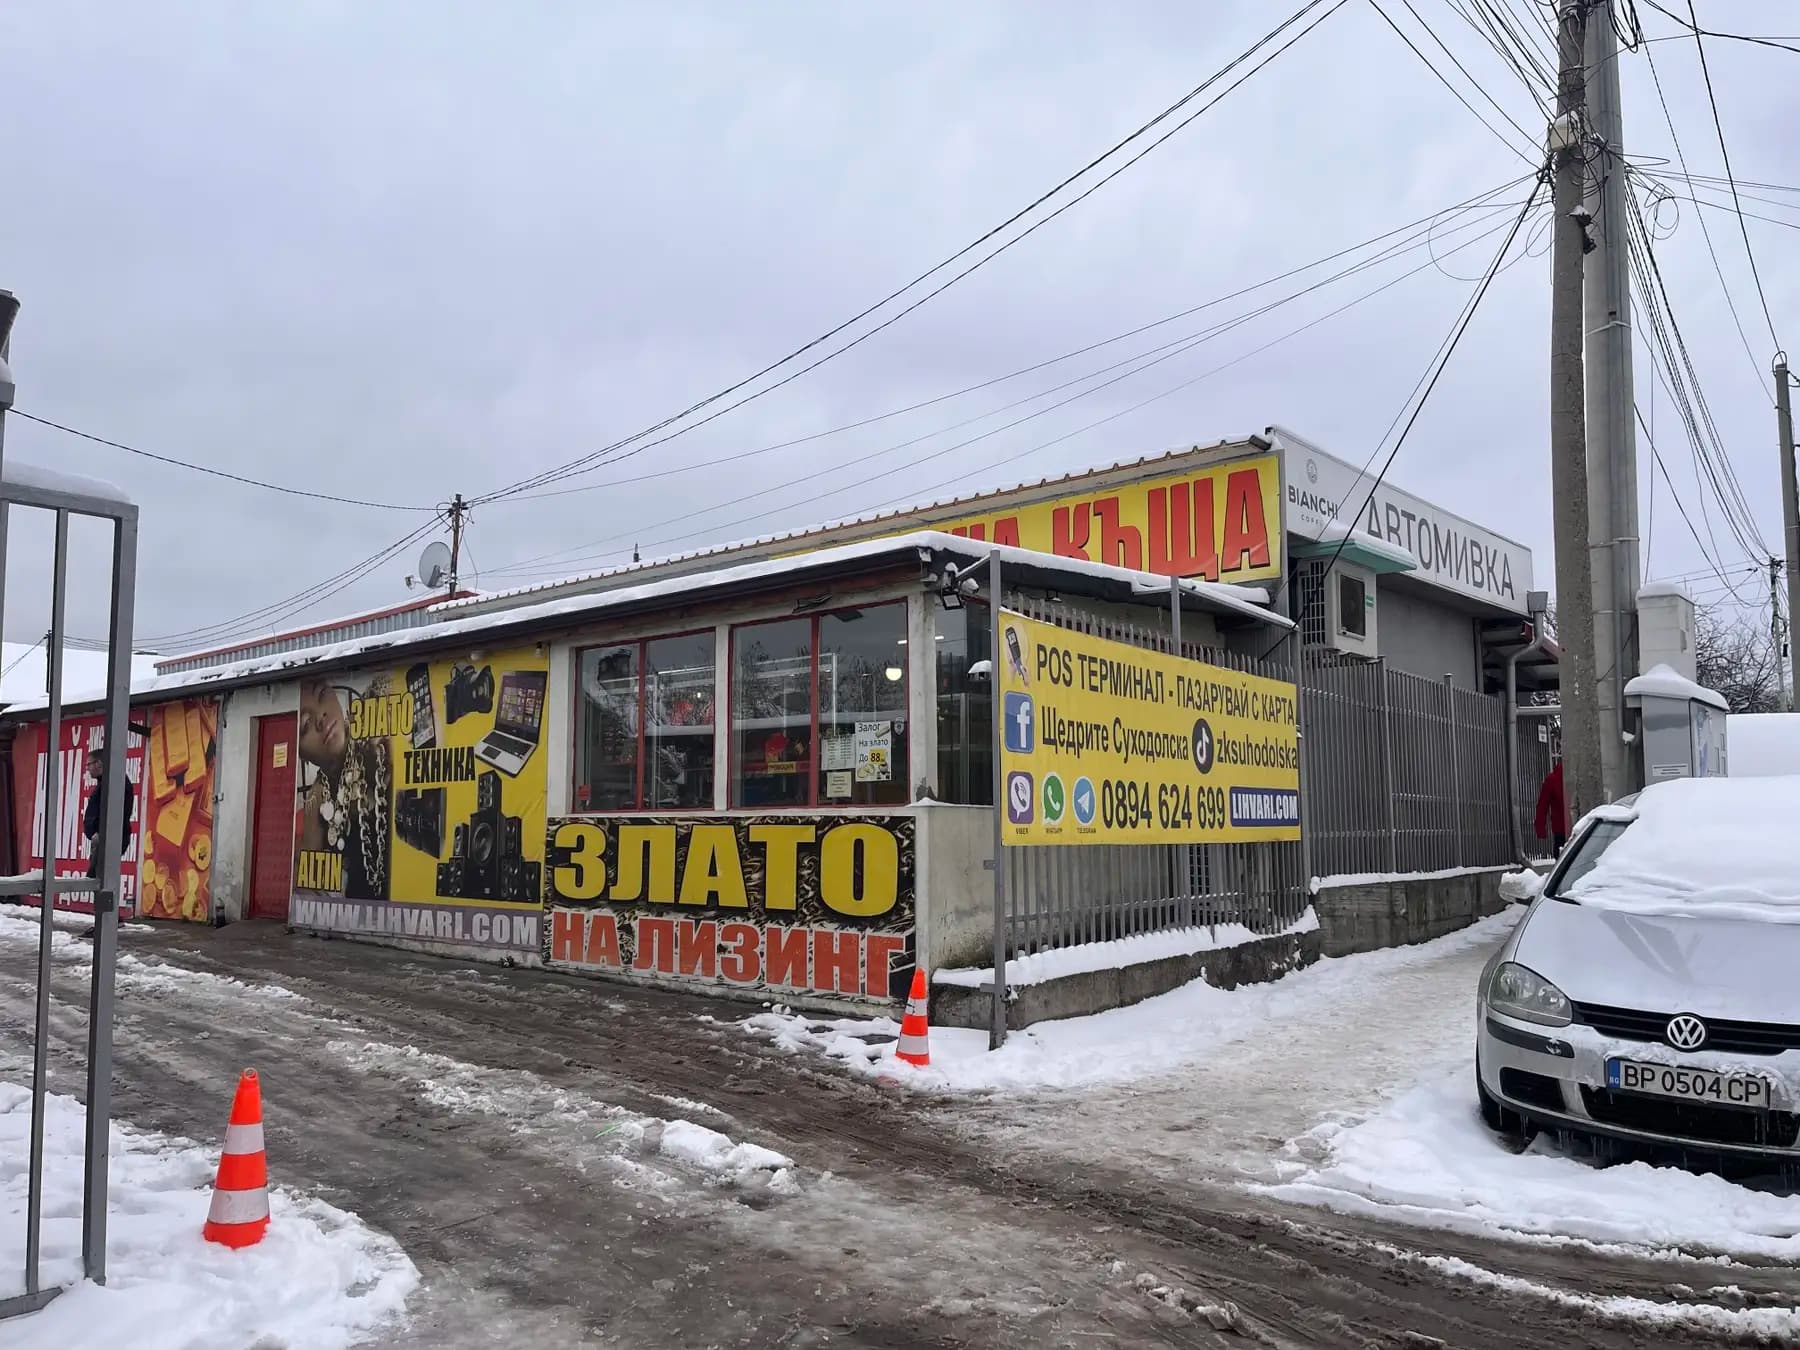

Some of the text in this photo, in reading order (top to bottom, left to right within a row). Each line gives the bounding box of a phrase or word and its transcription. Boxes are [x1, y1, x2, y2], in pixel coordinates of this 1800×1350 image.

[1052, 468, 1270, 582] КЪЩА
[1288, 484, 1339, 520] BIANCHI
[1366, 496, 1515, 600] АВТОМИВКА
[1037, 643, 1072, 688] POS
[1077, 653, 1164, 704] ТЕРМИНАЛ
[1177, 675, 1249, 718] ПАЗАРУВАЙ
[1251, 691, 1259, 720] С
[1261, 693, 1295, 726] КАРТА
[350, 692, 415, 740] ЗЛАТО
[1042, 705, 1189, 764] Щедрите Суходолска
[403, 746, 476, 784] ТЕХНИКА
[870, 752, 881, 762] 88
[1217, 730, 1298, 769] zksuhodolska
[1102, 779, 1226, 829] 0894 624 699
[1231, 792, 1298, 820] LIHVARI.COM
[297, 850, 343, 893] ALTIN
[553, 822, 900, 918] ЗЛАТО
[294, 899, 538, 946] WWW.LIHVARI.COM
[550, 910, 907, 998] НА ЛИЗИНГ
[1624, 1064, 1761, 1102] BP 0504 CP
